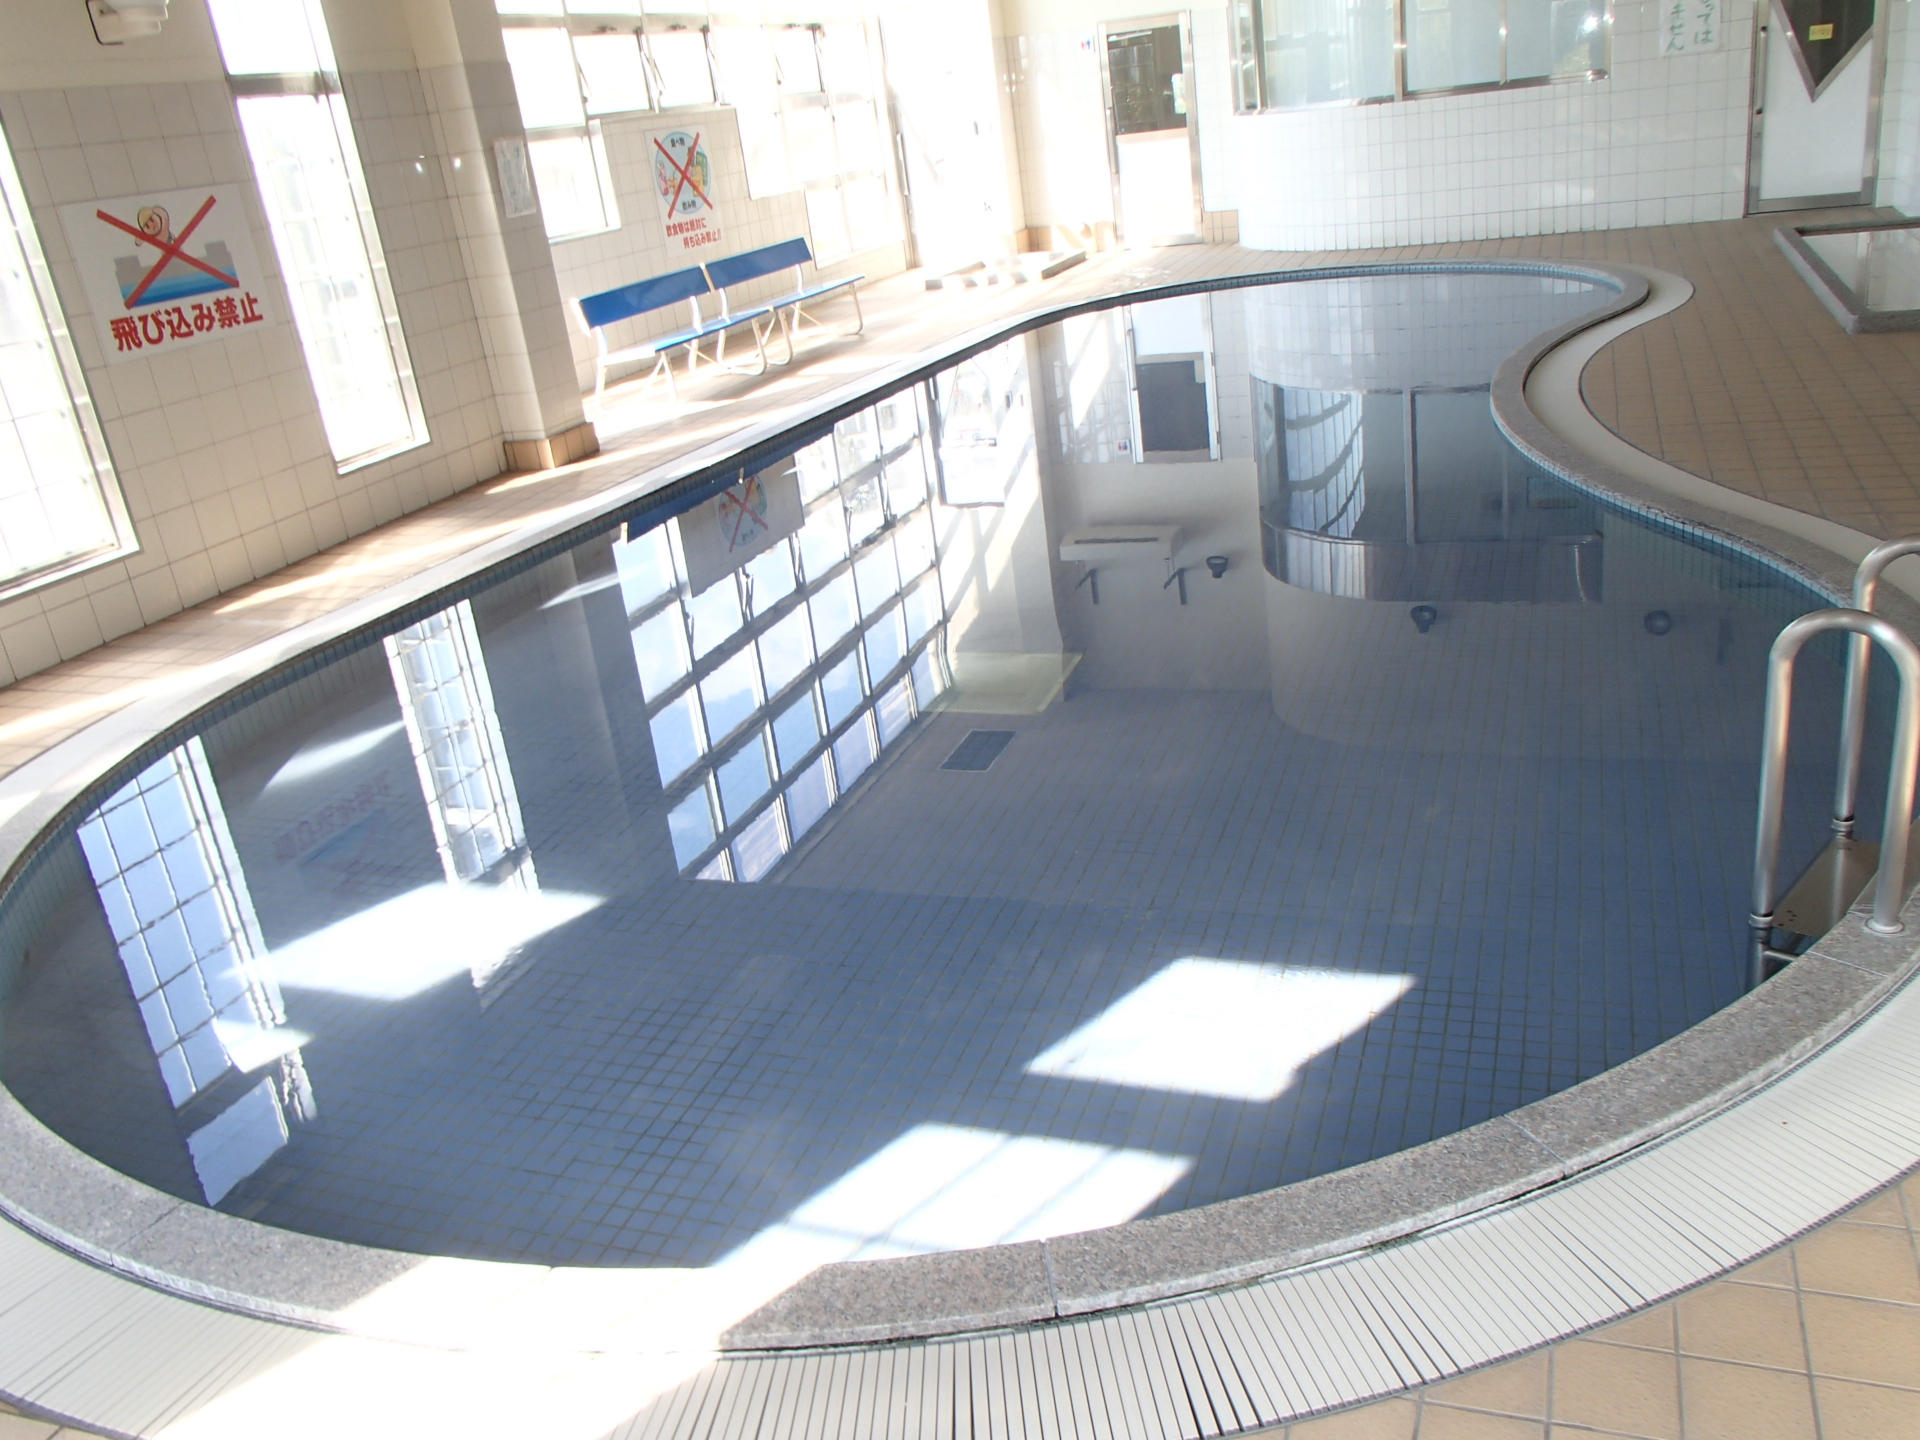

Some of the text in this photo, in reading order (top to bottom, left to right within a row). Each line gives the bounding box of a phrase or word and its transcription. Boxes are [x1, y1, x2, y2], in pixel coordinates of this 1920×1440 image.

[110, 292, 263, 352] 飛び込み禁止
